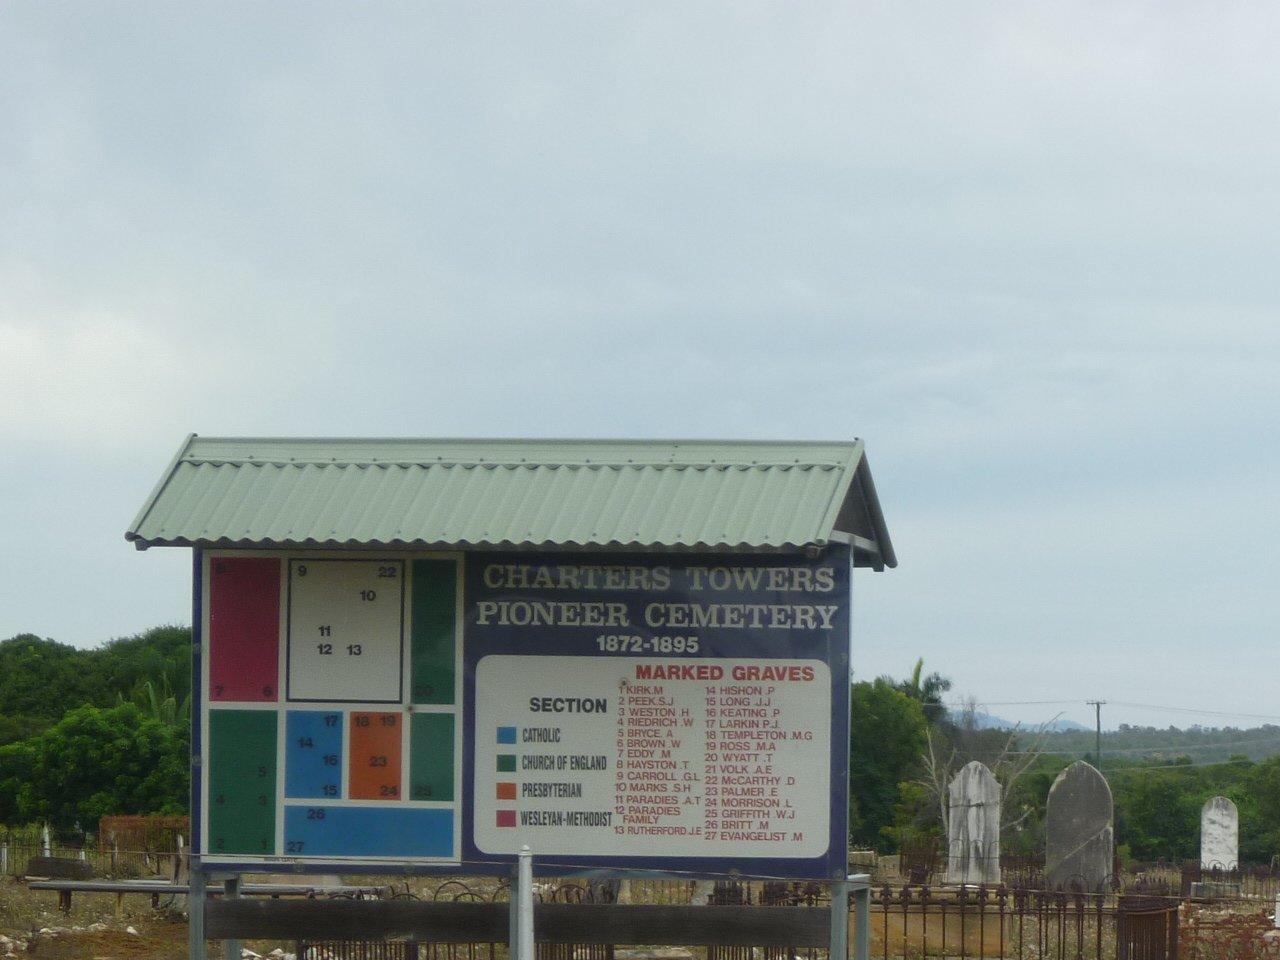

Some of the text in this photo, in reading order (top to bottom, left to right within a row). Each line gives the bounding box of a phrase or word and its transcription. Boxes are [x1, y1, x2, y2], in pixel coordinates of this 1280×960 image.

[297, 565, 307, 576] 9
[378, 567, 396, 578] 22
[483, 564, 834, 592] CHARTERS TOWERS
[360, 590, 376, 601] 10
[476, 600, 839, 630] PIONEER CEMETERY
[318, 625, 331, 636] 11
[597, 635, 699, 653] 1872-1895
[317, 644, 332, 655] 12
[346, 645, 362, 656] 13
[636, 664, 815, 681] MARKED GRAVES
[215, 686, 224, 696] 7
[705, 686, 716, 695] 14
[720, 686, 761, 695] HISHON
[530, 697, 607, 713] SECTION
[619, 697, 625, 705] 2
[705, 697, 716, 706] 15
[720, 697, 750, 706] LONG
[619, 708, 625, 716] 3
[629, 708, 675, 717] WESTON
[705, 708, 716, 717] 16
[720, 708, 767, 717] KEATING
[324, 715, 338, 727] 17
[355, 715, 370, 727] 18
[381, 715, 396, 727] 19
[628, 718, 677, 727] RIEDRICH
[705, 720, 715, 728] 17
[720, 720, 759, 728] LARKIN
[522, 727, 561, 743] CATHOLIC
[618, 729, 624, 737] 5
[705, 731, 716, 739] 18
[720, 731, 786, 740] TEMPLETON
[298, 737, 313, 748] 14
[617, 739, 623, 747] 6
[627, 739, 665, 748] BROWN
[706, 742, 716, 750] 19
[720, 742, 750, 750] ROSS
[618, 749, 623, 757] 7
[628, 749, 654, 758] EDDY
[705, 753, 718, 761] 20
[722, 753, 759, 762] WYATT
[323, 755, 338, 766] 16
[369, 756, 387, 767] 23
[522, 755, 607, 771] CHURCH OF ENGLAND
[617, 760, 623, 769] 8
[627, 760, 677, 769] HAYSTON
[705, 765, 716, 773] 21
[720, 765, 749, 774] VOLK
[617, 772, 623, 780] 9
[628, 772, 677, 780] CARROLL
[705, 776, 718, 784] 22
[721, 776, 780, 785] McCARTHY
[323, 785, 338, 796] 15
[380, 785, 397, 796] 24
[522, 782, 582, 798] PRESBYTERIAN
[616, 783, 627, 791] 10
[630, 783, 668, 792] MARKS
[705, 787, 718, 796] 23
[721, 787, 764, 796] PALMER
[615, 795, 623, 804] 11
[626, 796, 678, 804] PARADIES
[705, 798, 717, 807] 24
[721, 798, 780, 807] MORRISON
[307, 808, 325, 820] 26
[614, 806, 681, 815] 12 PARADIES
[705, 809, 717, 818] 25
[722, 809, 770, 818] GRIFFITH
[520, 811, 613, 827] WESLEYAN-METHODIST
[623, 815, 659, 824] FAMILY
[705, 820, 718, 829] 26
[721, 820, 753, 829] BRITT
[614, 826, 624, 834] 13
[628, 826, 686, 835] RUTHERFORD
[705, 832, 716, 840] 27
[720, 832, 787, 841] EVANGELIST
[287, 841, 304, 852] 27
